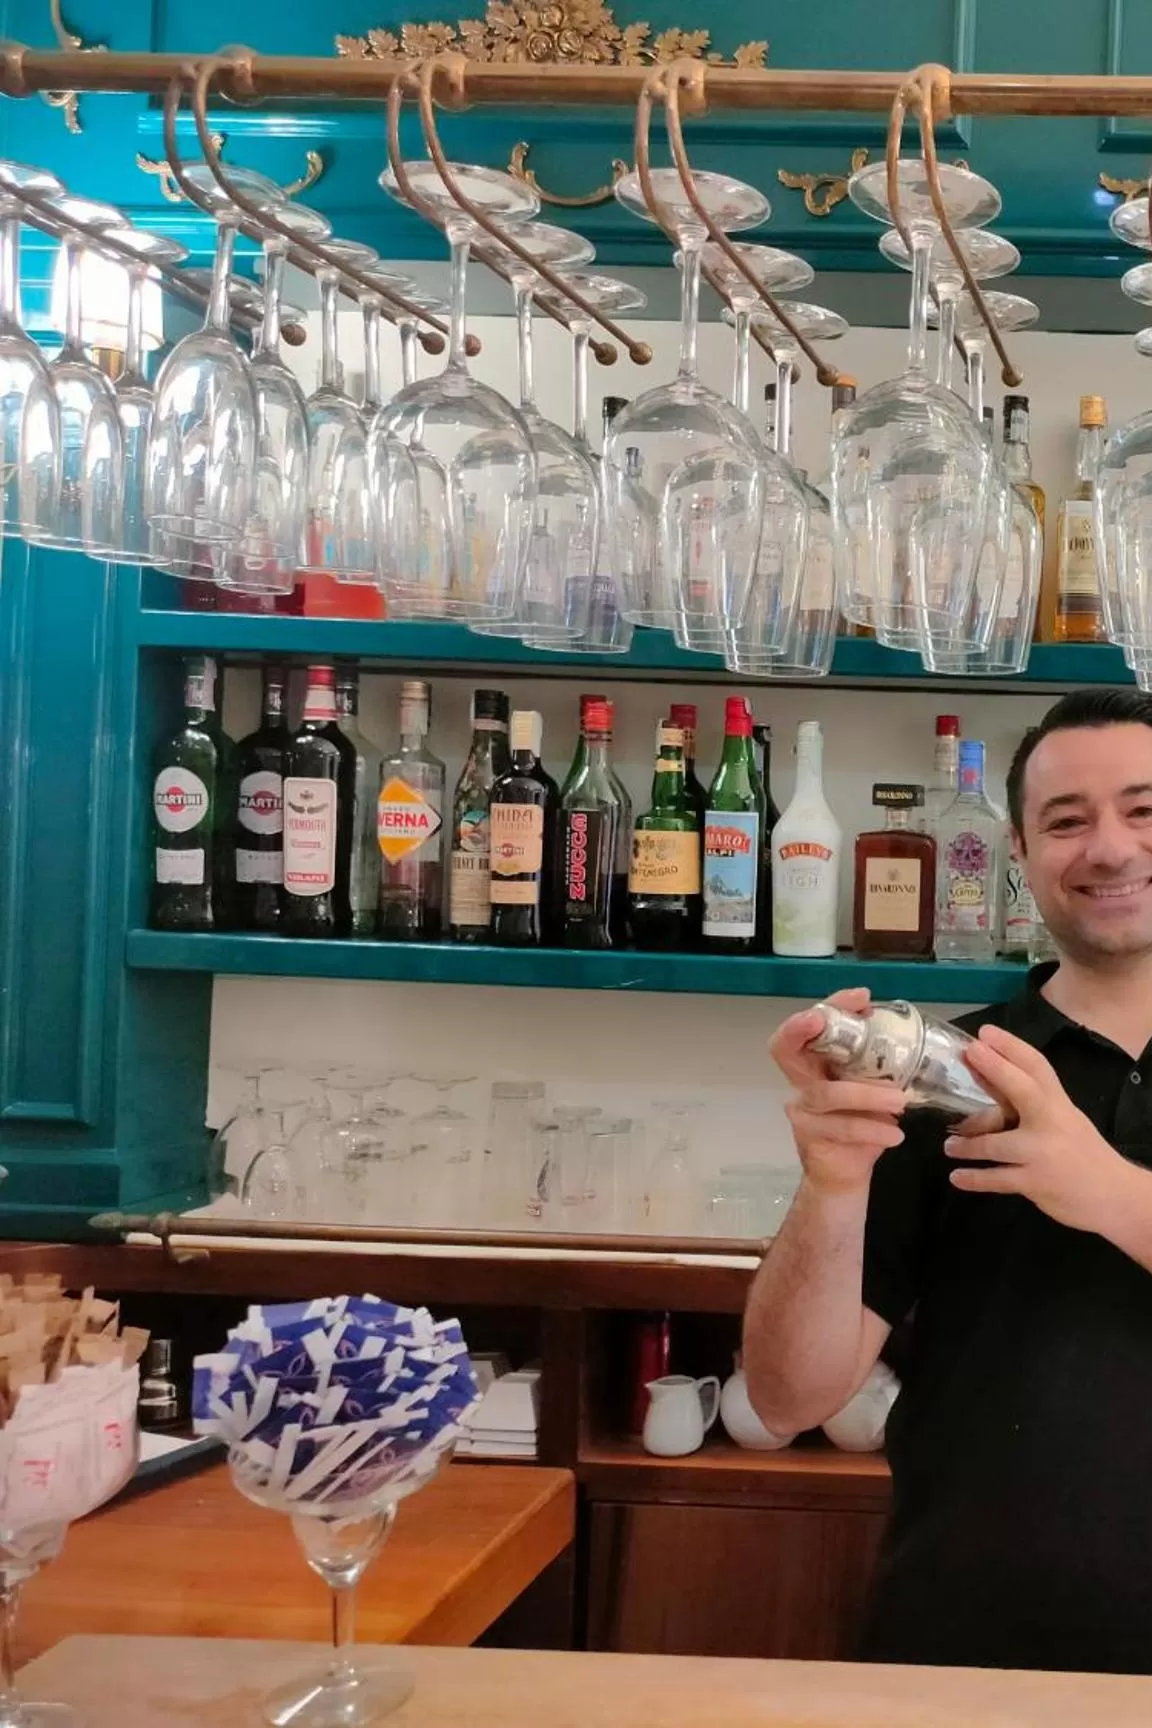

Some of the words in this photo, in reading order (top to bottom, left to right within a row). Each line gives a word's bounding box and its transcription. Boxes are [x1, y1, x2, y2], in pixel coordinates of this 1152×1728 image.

[156, 793, 203, 806] MARTINI
[239, 796, 284, 809] MARTI
[569, 813, 588, 901] ZUCCA
[781, 843, 829, 860] BAILEYS
